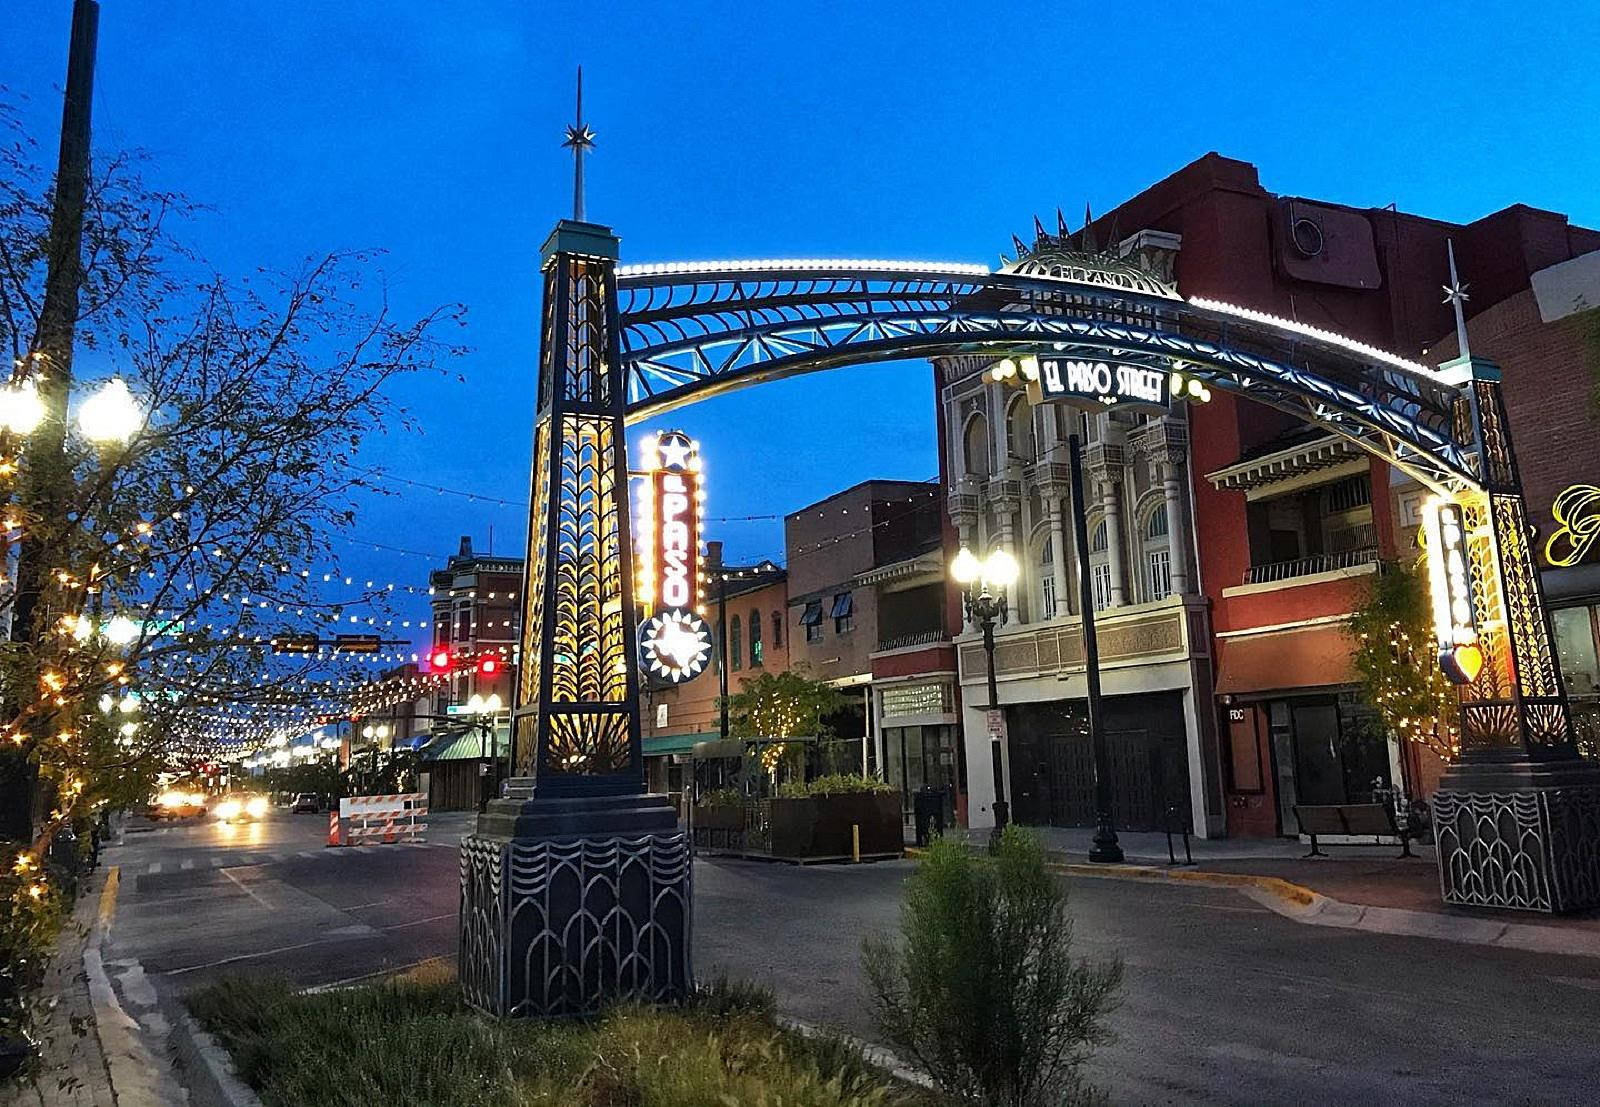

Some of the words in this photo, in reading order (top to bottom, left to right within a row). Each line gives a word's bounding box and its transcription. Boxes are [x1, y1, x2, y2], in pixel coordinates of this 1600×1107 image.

[1083, 268, 1123, 287] PASO
[1043, 361, 1065, 392] EL
[1066, 361, 1112, 394] PASO
[1116, 365, 1164, 403] STREET
[663, 493, 688, 606] PASO
[1230, 709, 1244, 720] FDC
